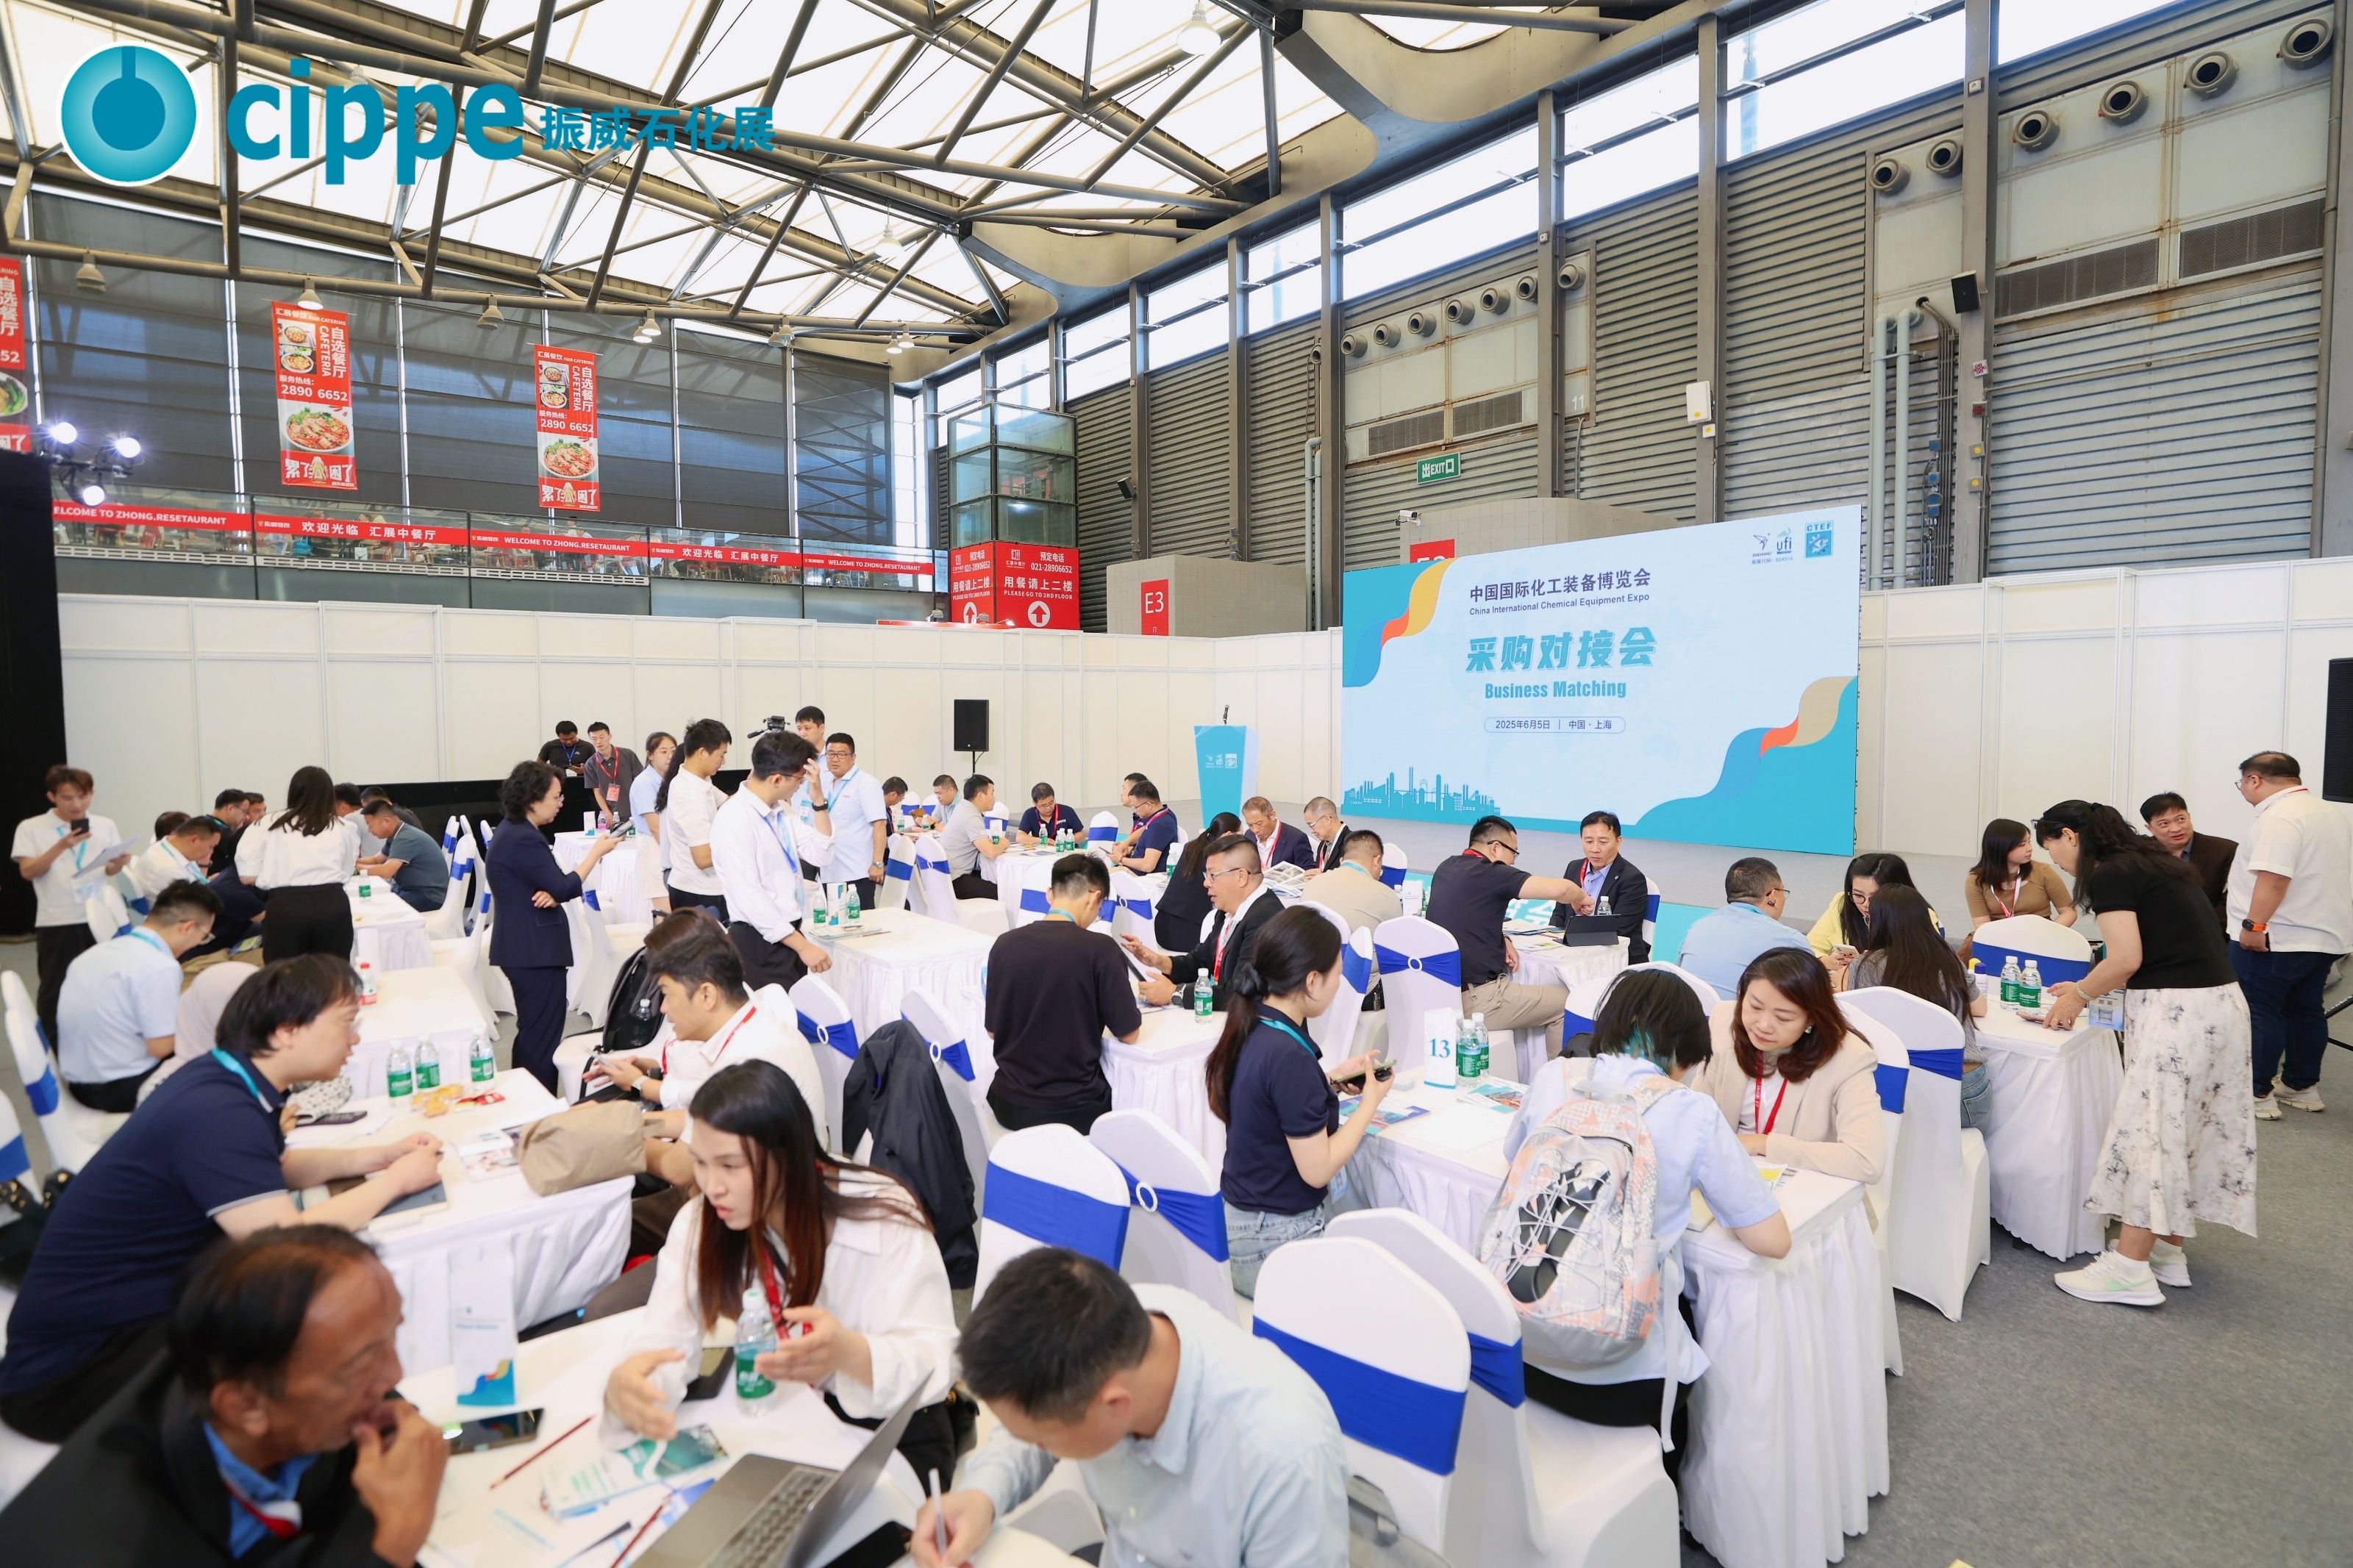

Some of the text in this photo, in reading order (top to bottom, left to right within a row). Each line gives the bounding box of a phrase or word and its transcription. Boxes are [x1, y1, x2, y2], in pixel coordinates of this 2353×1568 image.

[321, 318, 346, 326] CATERING
[319, 325, 331, 377] CAFETERIA
[331, 327, 347, 379] 自选餐厅
[281, 384, 348, 401] 2890 6652
[572, 365, 581, 411] CAFETERIA
[582, 367, 594, 412] 自选餐厅
[540, 419, 594, 433] 2890 6652
[99, 509, 114, 518] TO
[115, 510, 226, 525] ZHONG.RESETAURANT
[301, 520, 437, 540] 欢迎光临 汇展中餐厅
[1807, 523, 1832, 531] CTEF
[504, 537, 540, 546] WELCOME
[553, 540, 630, 551] ZHONG.RESETAURANT
[1777, 537, 1791, 551] ufi
[682, 548, 779, 563] 欢迎光临 汇展中餐厅
[970, 549, 985, 562] 预定电话
[1040, 551, 1064, 562] 预定电话
[828, 559, 854, 567] WELCOME
[864, 562, 921, 572] ZHONG.RESETAURANT
[964, 561, 990, 573] 021-28906652
[1031, 562, 1072, 573] 021-28906652
[953, 576, 990, 593] 用餐请上二楼
[1004, 576, 1072, 592] 用餐请上二楼
[1470, 568, 1651, 603] 中国国际化工装备博览会
[1145, 591, 1164, 614] E3
[1470, 593, 1650, 615] China International Chemical Equipment Expo
[1465, 626, 1657, 673] 采购对接会
[1485, 680, 1627, 698] Business Matching
[1496, 720, 1550, 730] 2025年6月5日
[1429, 1038, 1450, 1059] 13
